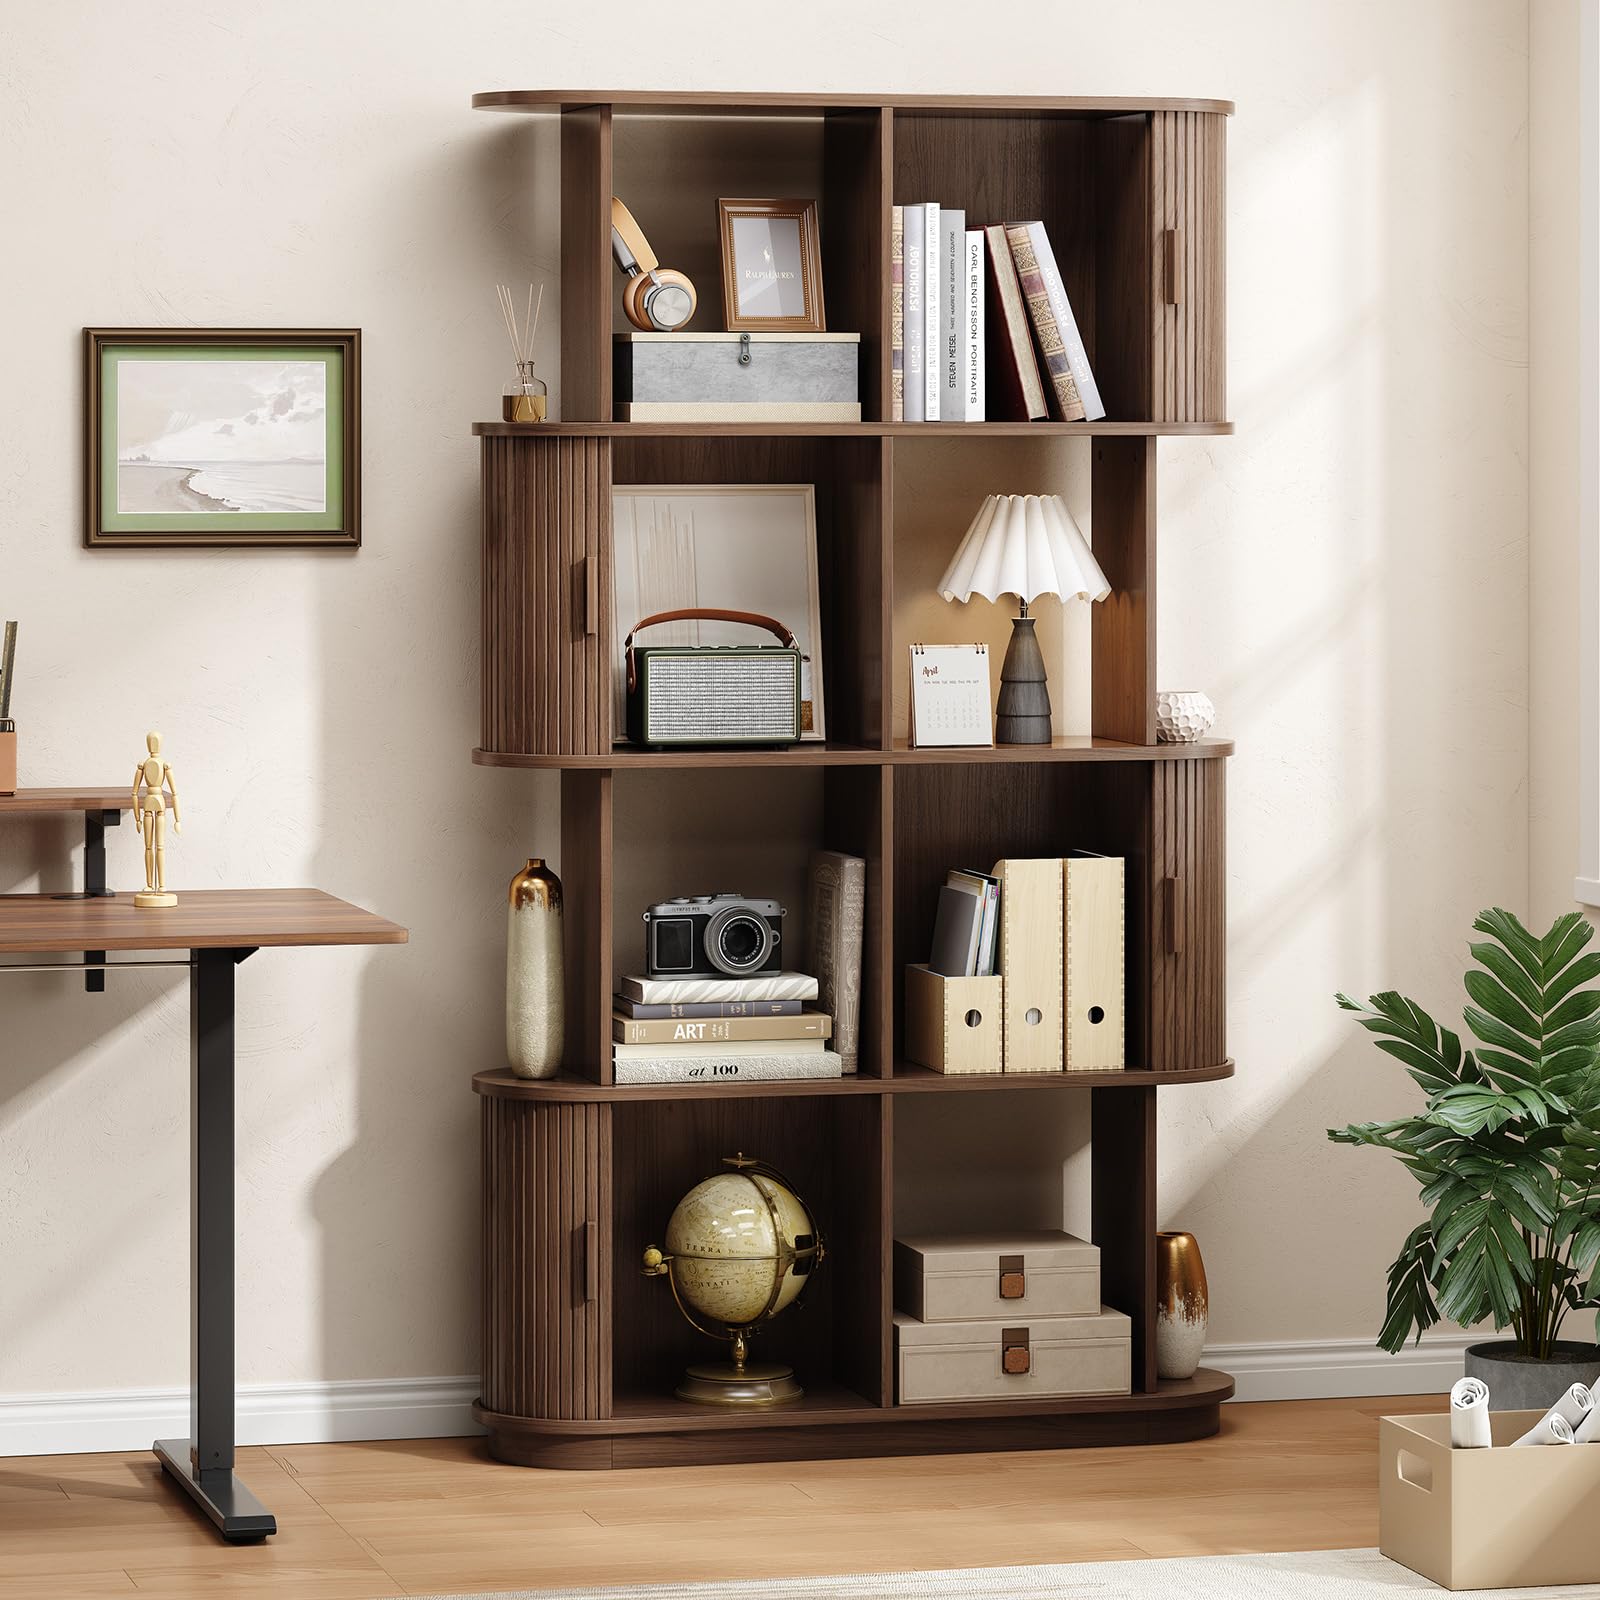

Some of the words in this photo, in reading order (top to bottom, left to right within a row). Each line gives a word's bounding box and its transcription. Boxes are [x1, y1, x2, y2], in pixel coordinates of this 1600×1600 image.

[970, 245, 978, 271] CARL
[769, 271, 795, 279] LAUREN
[909, 245, 920, 311] PSYCHOLOGY
[970, 275, 978, 339] BENGTSSON
[1044, 267, 1069, 328] PSYCHOLOGY
[948, 334, 957, 358] MEISEL
[948, 362, 957, 388] STEVEN
[970, 345, 978, 404] PORTRAITS
[922, 666, 939, 677] April
[674, 1023, 707, 1040] ART
[688, 1066, 706, 1077] at
[712, 1065, 739, 1076] 100
[686, 1243, 721, 1254] TERRA
